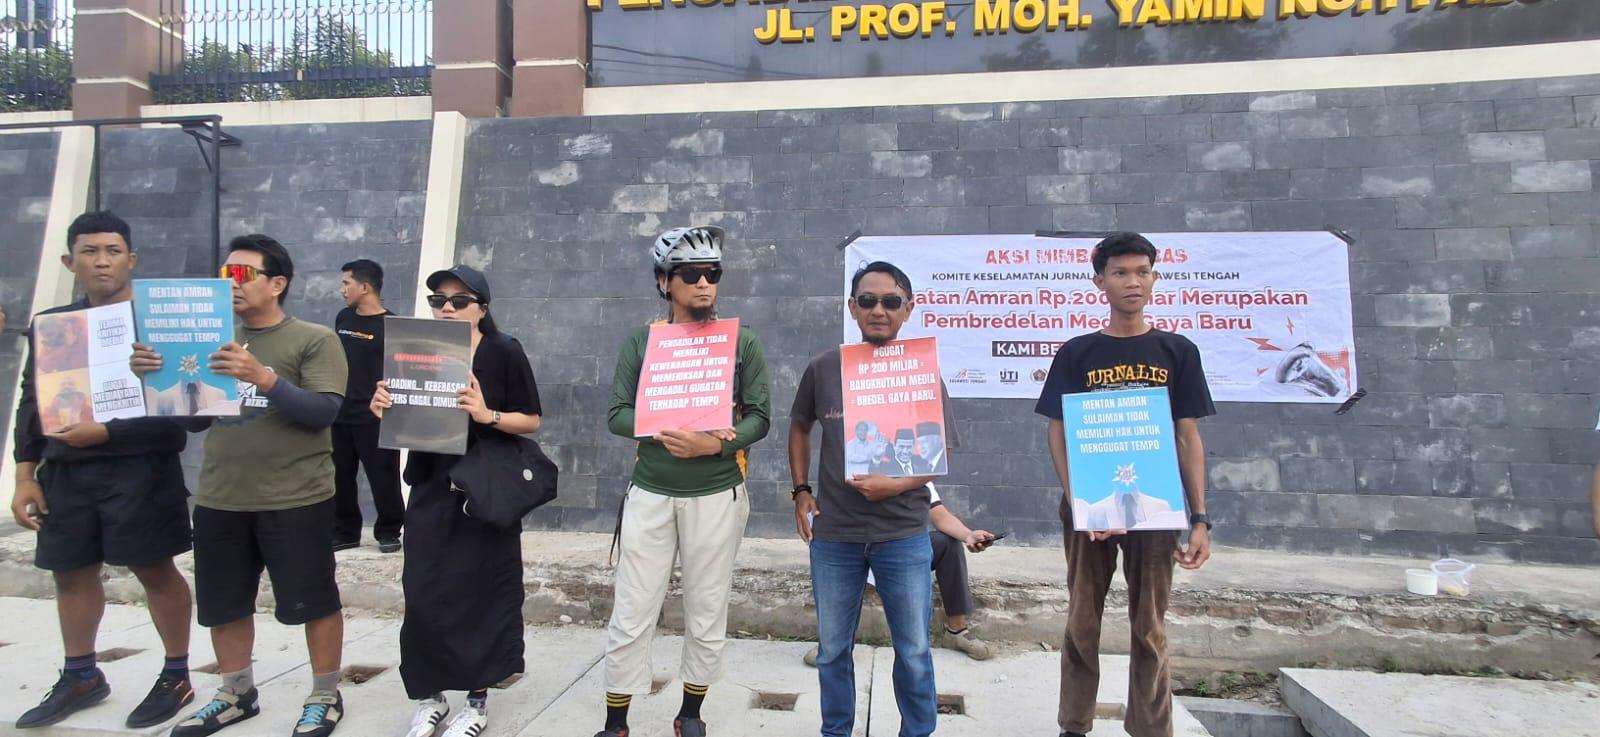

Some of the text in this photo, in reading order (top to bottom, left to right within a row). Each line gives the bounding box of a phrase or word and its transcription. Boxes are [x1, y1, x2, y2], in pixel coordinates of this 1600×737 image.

[754, 8, 815, 43] JL.
[830, 2, 957, 41] PROF.
[973, 0, 1093, 34] MOH.
[1110, 0, 1264, 27] YAMIN
[986, 249, 1030, 264] AKSI
[932, 271, 1240, 281] KOMITE KESELAMATAN JURNAL AWESI TENGAH
[148, 286, 213, 298] MENTAN AMRAN
[913, 290, 960, 305] atan
[965, 289, 1032, 305] Amran
[1181, 289, 1308, 309] Merupakan
[149, 302, 214, 314] SULAIMAN TIDAK
[144, 318, 223, 329] MEMILIKI HAK UNTUK
[924, 312, 1063, 329] Pembredelan
[1200, 314, 1252, 330] Baru
[148, 332, 220, 342] MENGGUGAT TEMPO
[658, 334, 728, 349] PENGADILAN TIDAK
[672, 347, 709, 358] MEMILIKI
[873, 344, 905, 358] #GUGAT
[996, 343, 1063, 356] KAMI BE
[649, 356, 728, 372] KEWENANGAN UNTUK
[858, 363, 869, 375] RP
[871, 362, 888, 373] 200
[890, 359, 918, 371] MILIAR
[706, 369, 723, 378] DAN
[1086, 363, 1169, 388] JURNALIS
[644, 381, 726, 397] MENGADILI GUGATAN
[849, 372, 936, 391] BANGKRUTKAN MEDIA
[409, 394, 432, 406] GAGAL
[433, 396, 463, 408] DIMUA
[649, 396, 719, 412] TERHADAP TEMPO
[856, 393, 887, 406] BREDEL
[888, 391, 910, 404] GAYA
[912, 389, 936, 402] BARU.
[1082, 395, 1147, 410] MENTAN AMRAN
[1082, 410, 1150, 425] SULAIMAN TIDAK
[1076, 424, 1161, 440] MEMILIKI HAK UNTUK
[1080, 440, 1160, 454] MENGGUGAT TEMPO
